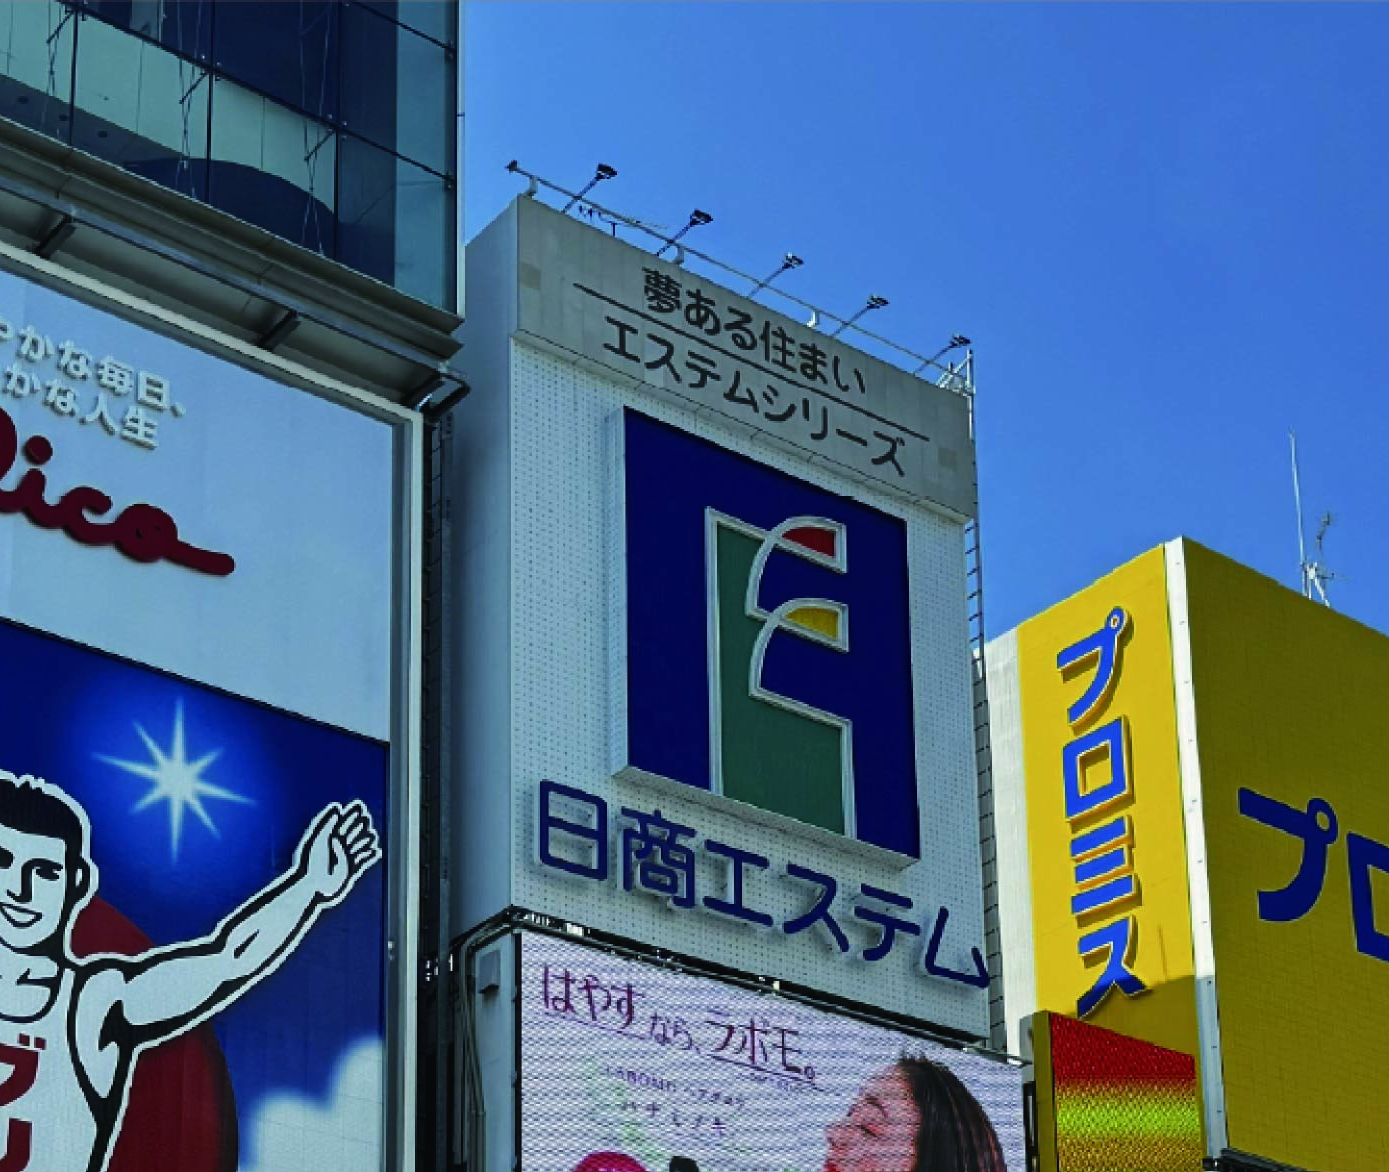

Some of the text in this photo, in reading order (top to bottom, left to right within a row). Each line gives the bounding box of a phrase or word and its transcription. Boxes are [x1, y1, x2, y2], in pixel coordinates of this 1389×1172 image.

[602, 314, 908, 478] エステムシリーズ
[641, 267, 866, 397] 夢ある住まい
[537, 780, 990, 989] 日商エステム
[1056, 605, 1148, 1018] プロミス
